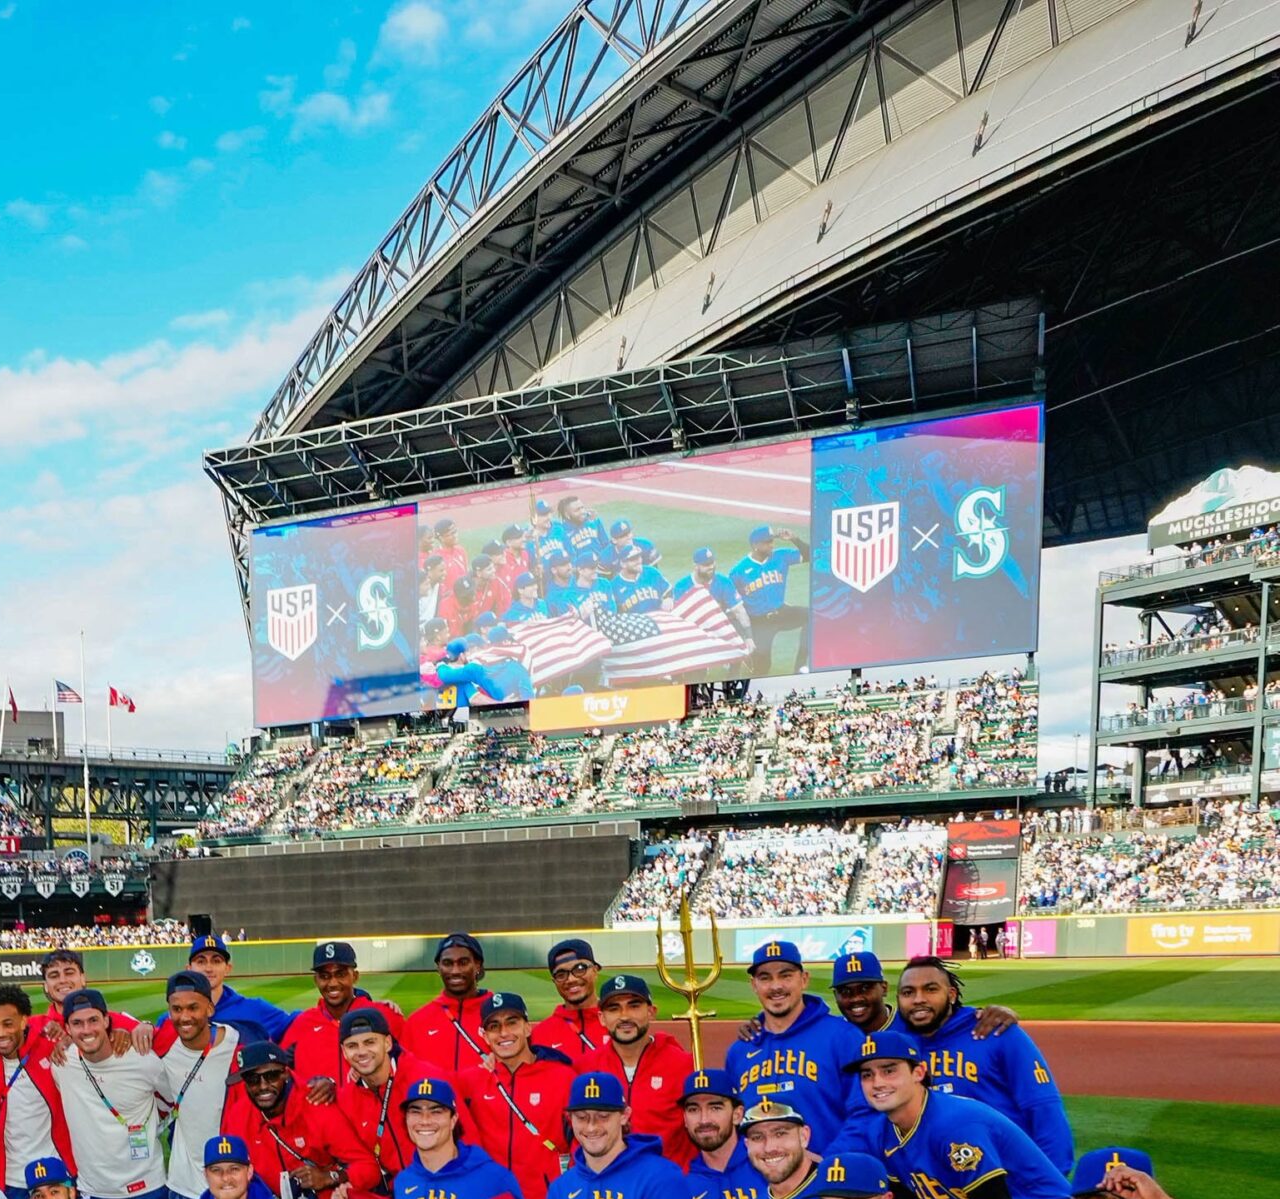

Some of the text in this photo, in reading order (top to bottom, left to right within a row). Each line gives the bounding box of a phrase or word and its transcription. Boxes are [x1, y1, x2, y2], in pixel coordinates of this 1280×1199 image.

[837, 507, 894, 543] USA
[1190, 514, 1270, 539] INDIAN TRIBE
[271, 589, 313, 618] USA
[6, 884, 17, 894] 24
[42, 883, 50, 893] 11
[75, 881, 86, 892] 51
[110, 880, 120, 891] 51
[946, 896, 1012, 907] TOYOTA
[740, 1050, 818, 1093] seattle
[929, 1050, 978, 1083] ttle
[952, 1145, 973, 1164] 50
